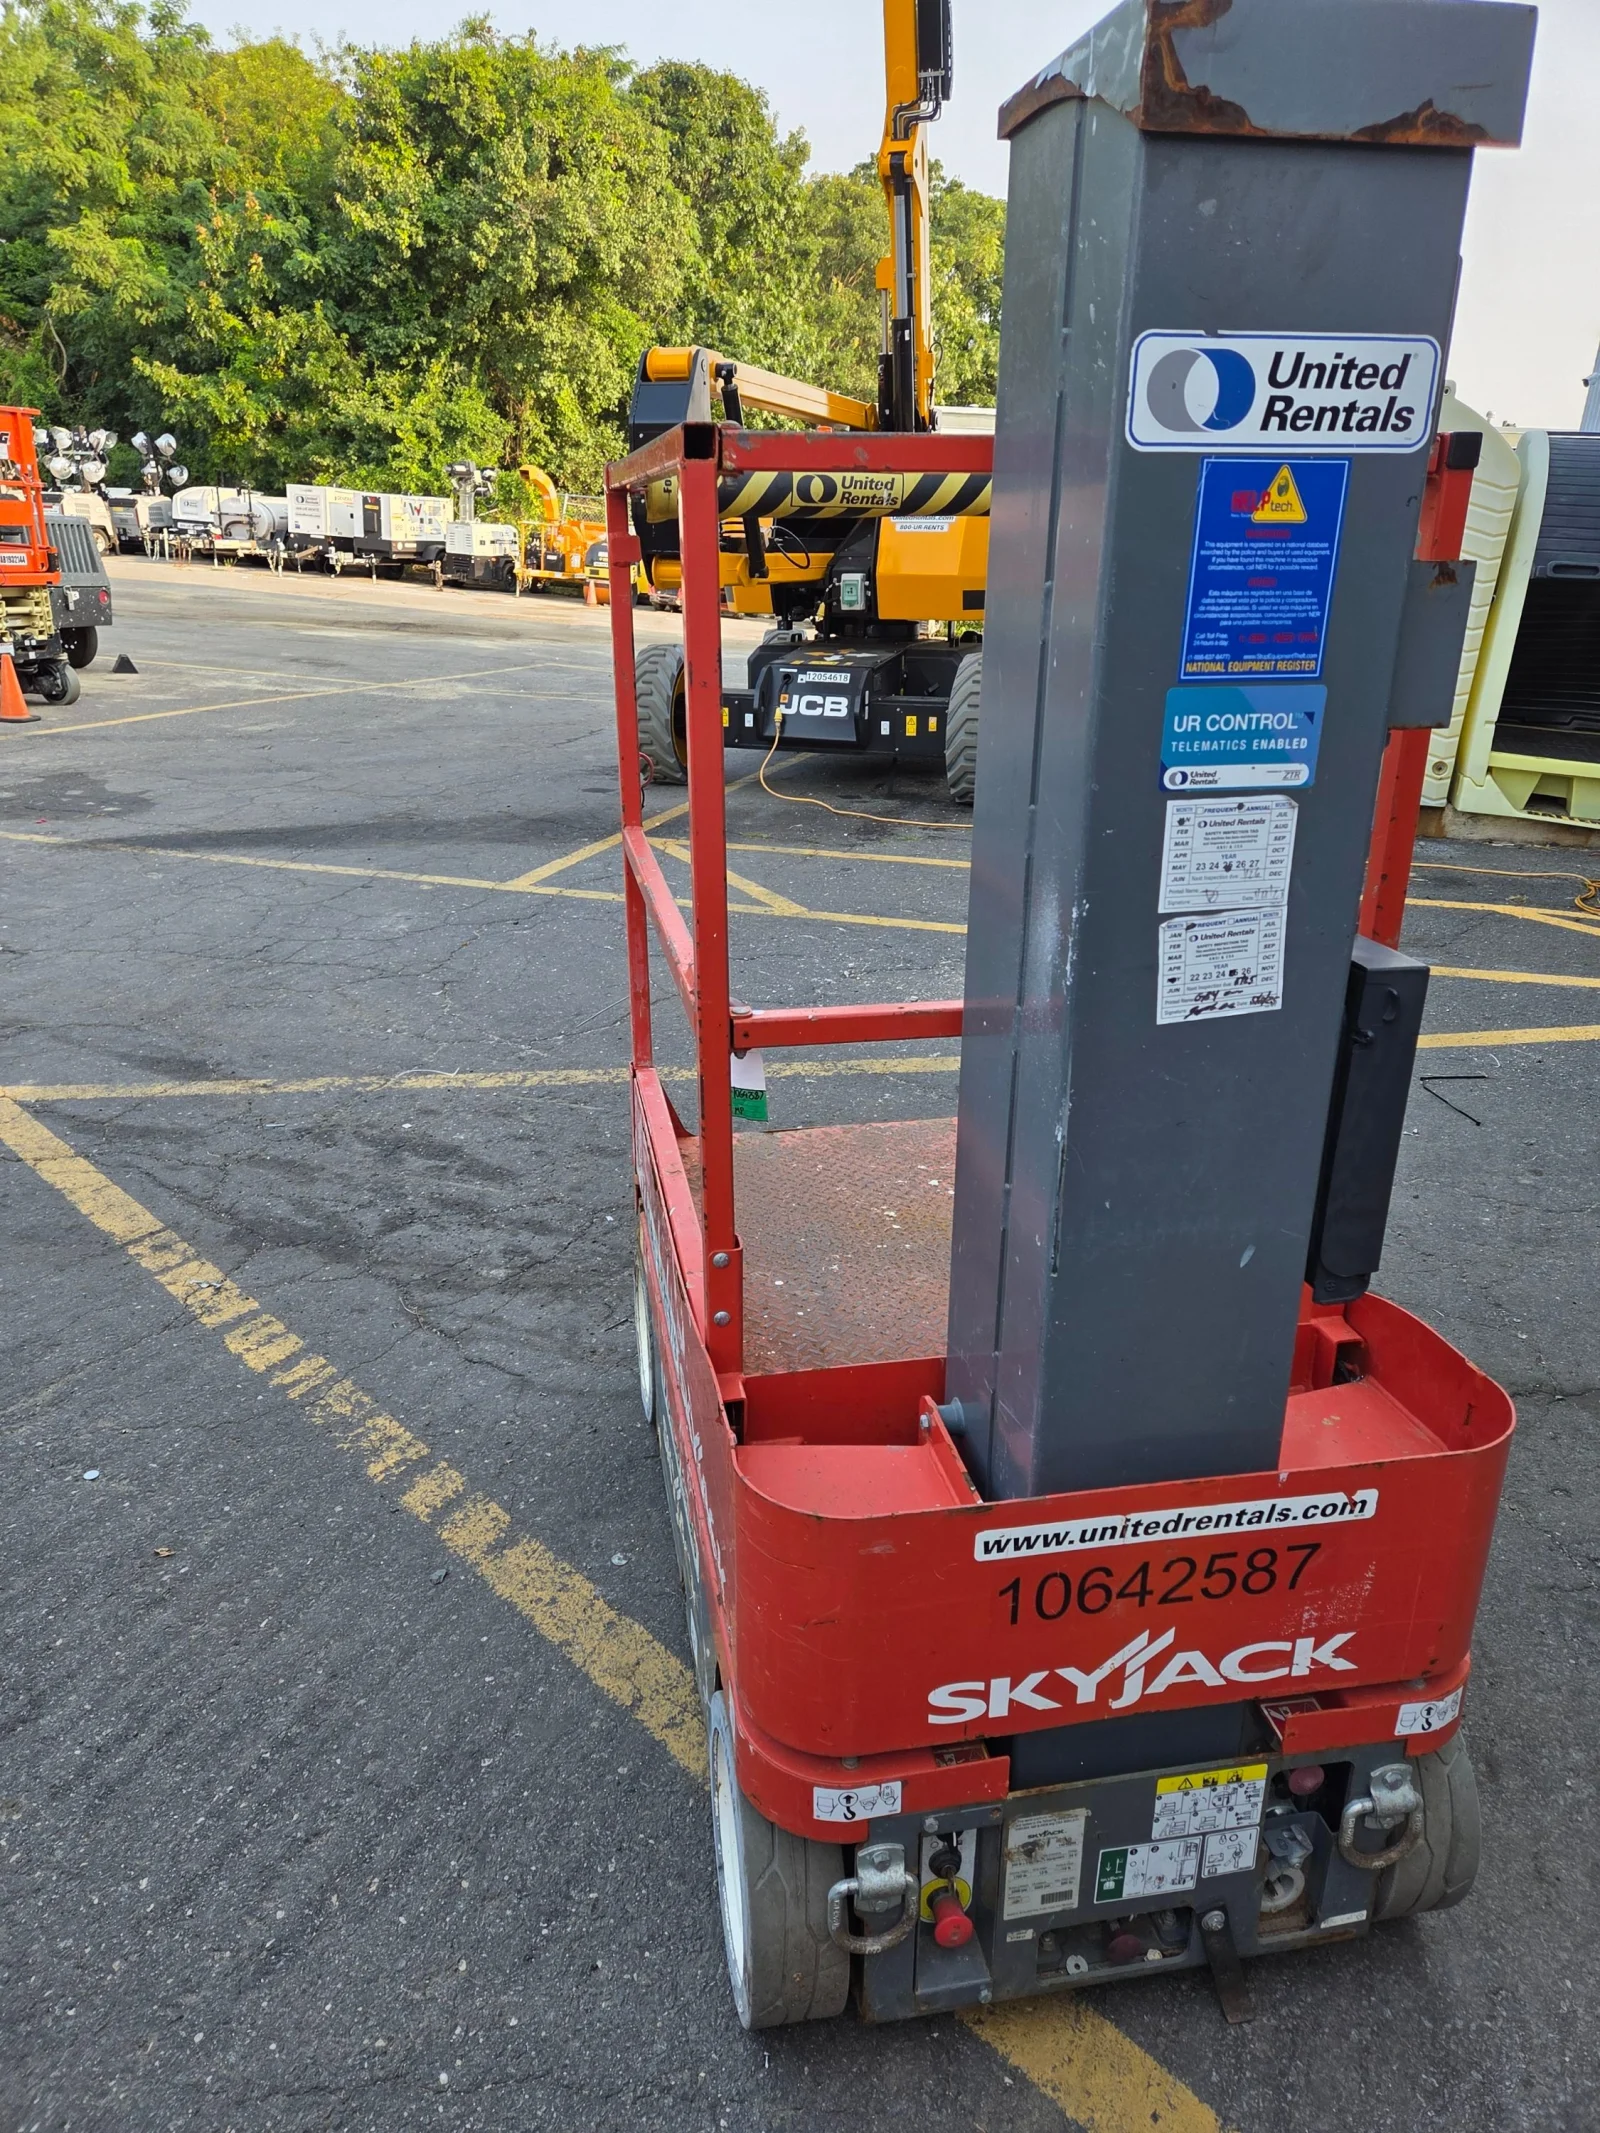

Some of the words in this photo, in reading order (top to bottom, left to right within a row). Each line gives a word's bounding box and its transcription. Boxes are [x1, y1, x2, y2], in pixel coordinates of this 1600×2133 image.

[1267, 351, 1412, 390] United
[1259, 395, 1415, 432] Rentals
[840, 475, 895, 492] United
[839, 491, 898, 507] Rentals
[1186, 661, 1226, 673] NATIONAL
[1228, 660, 1274, 672] EQUIPMENT
[1276, 659, 1316, 671] REGISTER
[807, 672, 849, 682] 12054618
[780, 694, 848, 717] JCB
[1173, 715, 1200, 732] UR
[1206, 713, 1298, 731] CONTROL
[1171, 740, 1246, 752] TELEMATICS
[1253, 738, 1307, 750] ENABLED
[1201, 932, 1225, 940] United
[1241, 967, 1251, 975] 26
[982, 1497, 1368, 1555] www.unitedrentals.com
[998, 1542, 1322, 1626] 10642587
[927, 1626, 1359, 1725] SKYJACK
